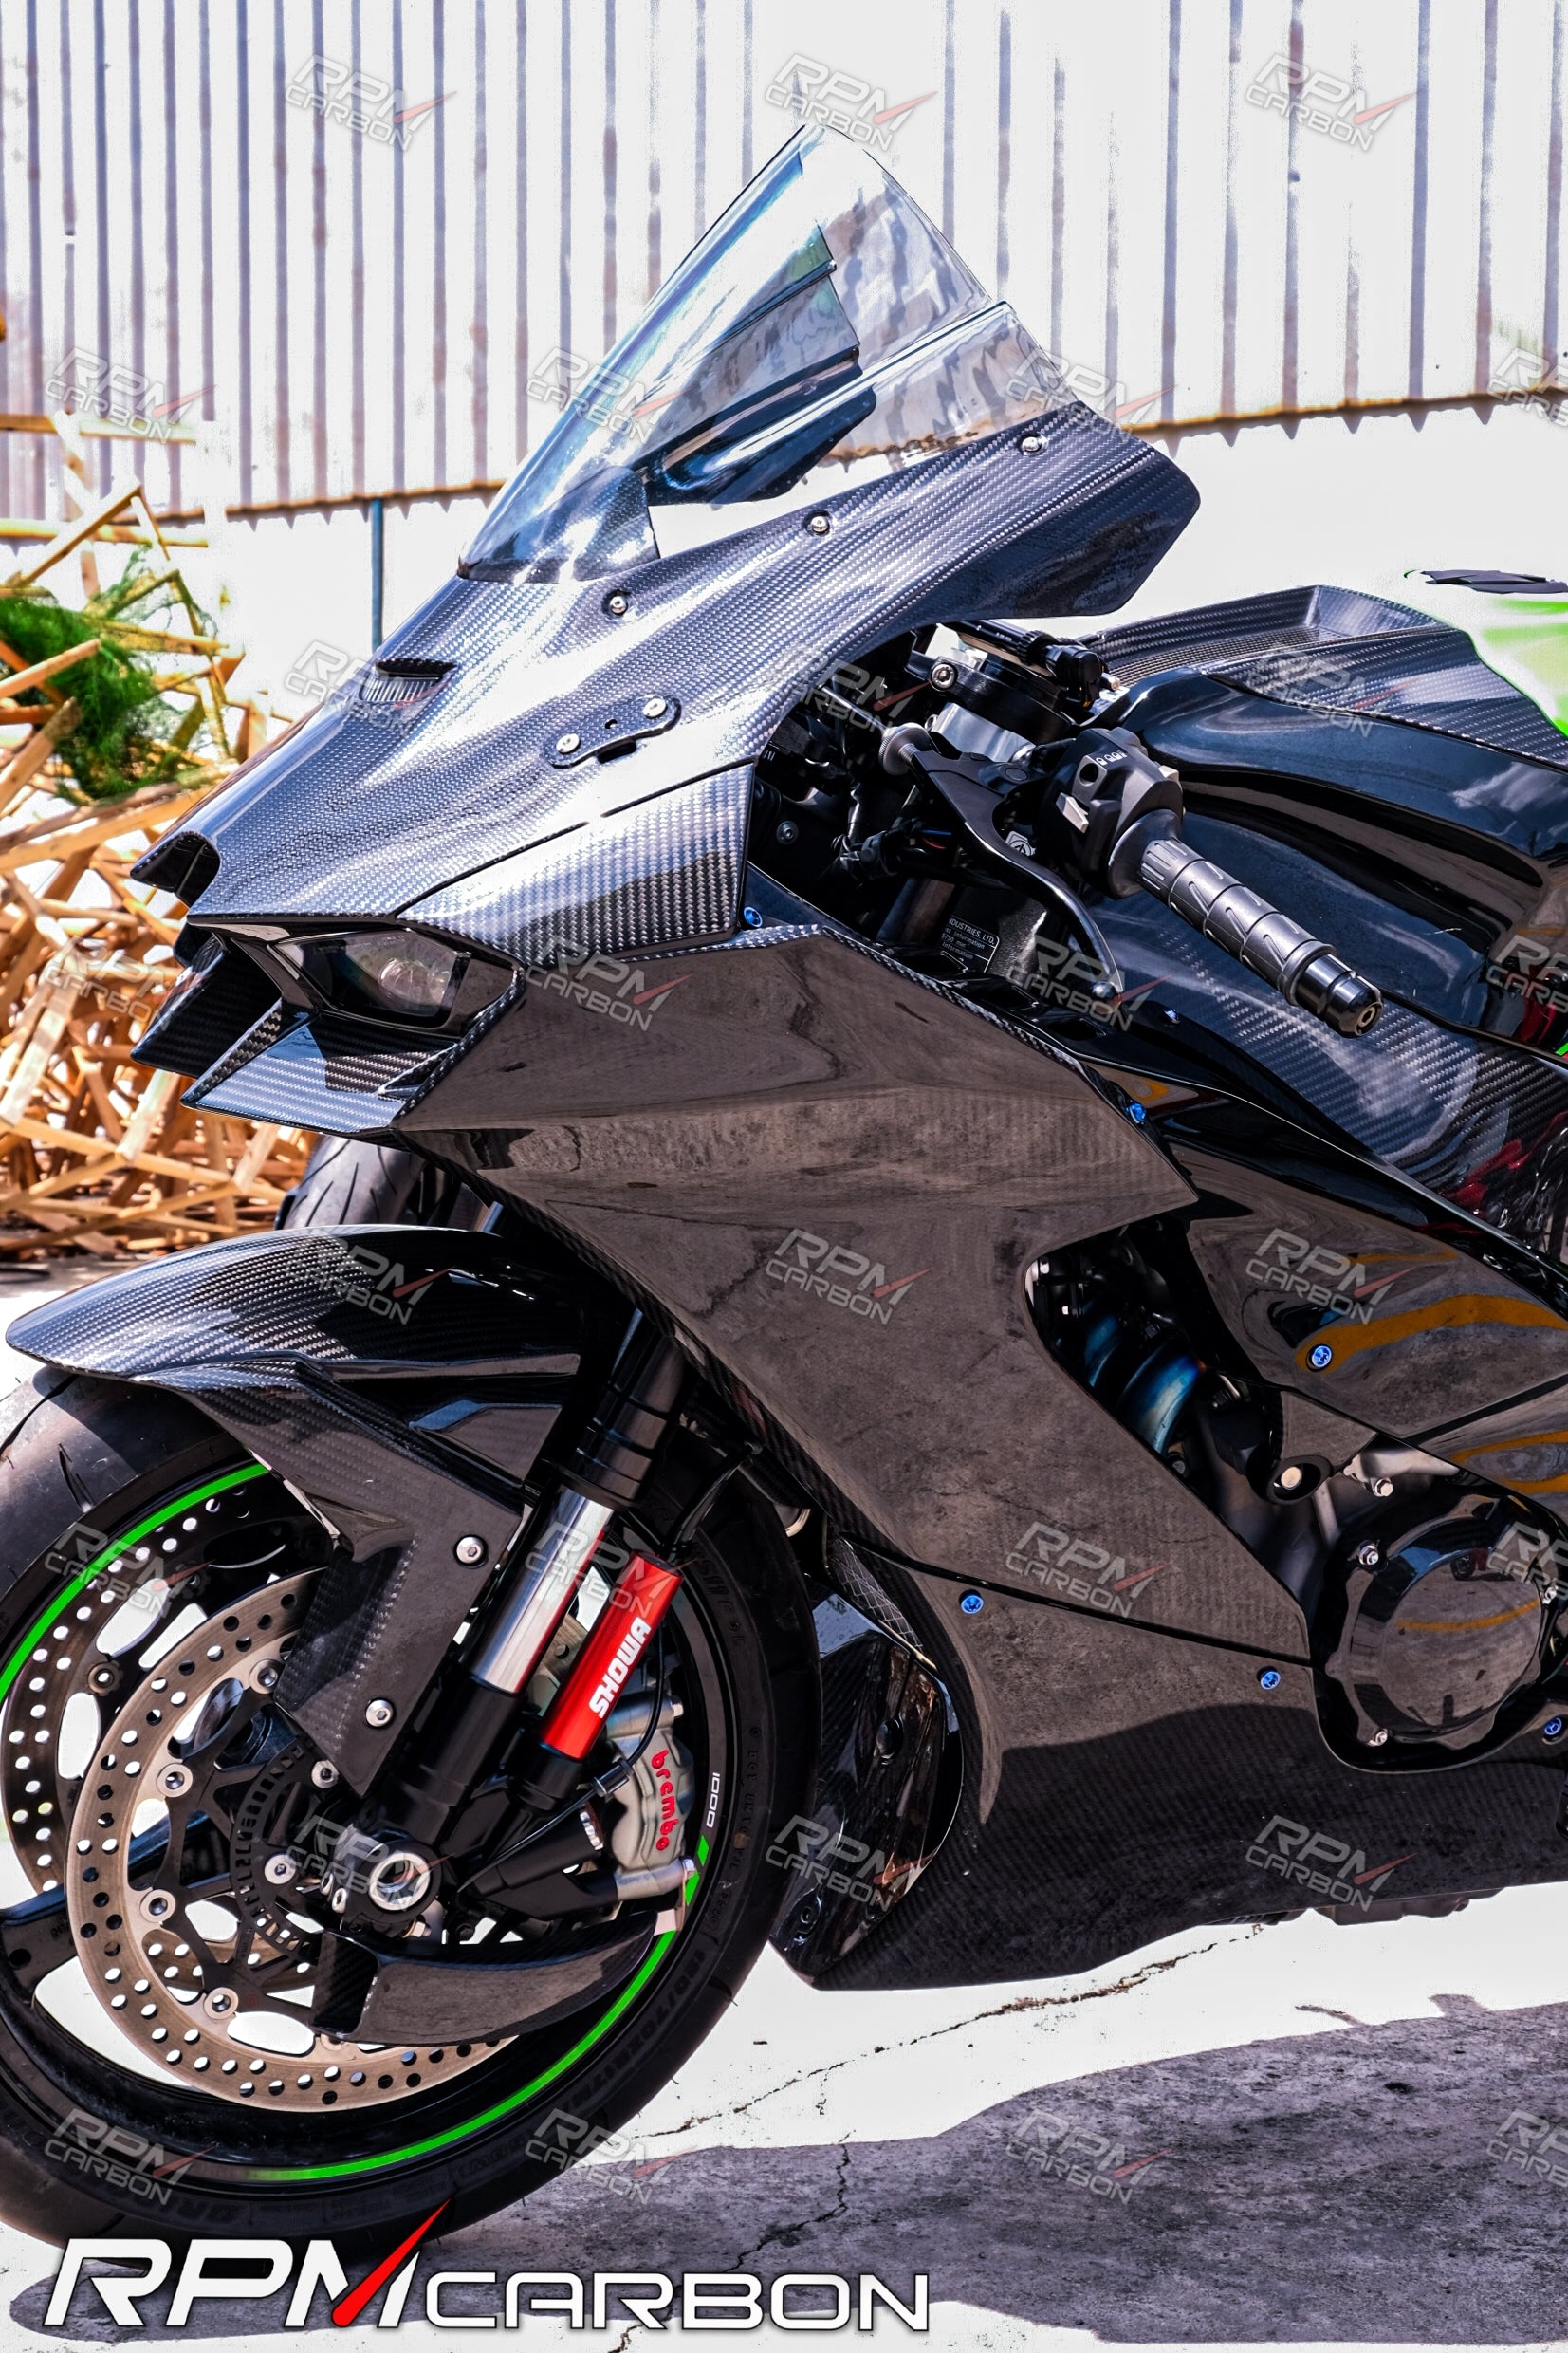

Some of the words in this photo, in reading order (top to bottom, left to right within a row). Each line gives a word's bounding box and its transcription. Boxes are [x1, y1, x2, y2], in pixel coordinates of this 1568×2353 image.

[589, 1616, 652, 1719] SHOWA
[651, 1749, 679, 1851] brembo
[705, 1772, 721, 1828] 1000
